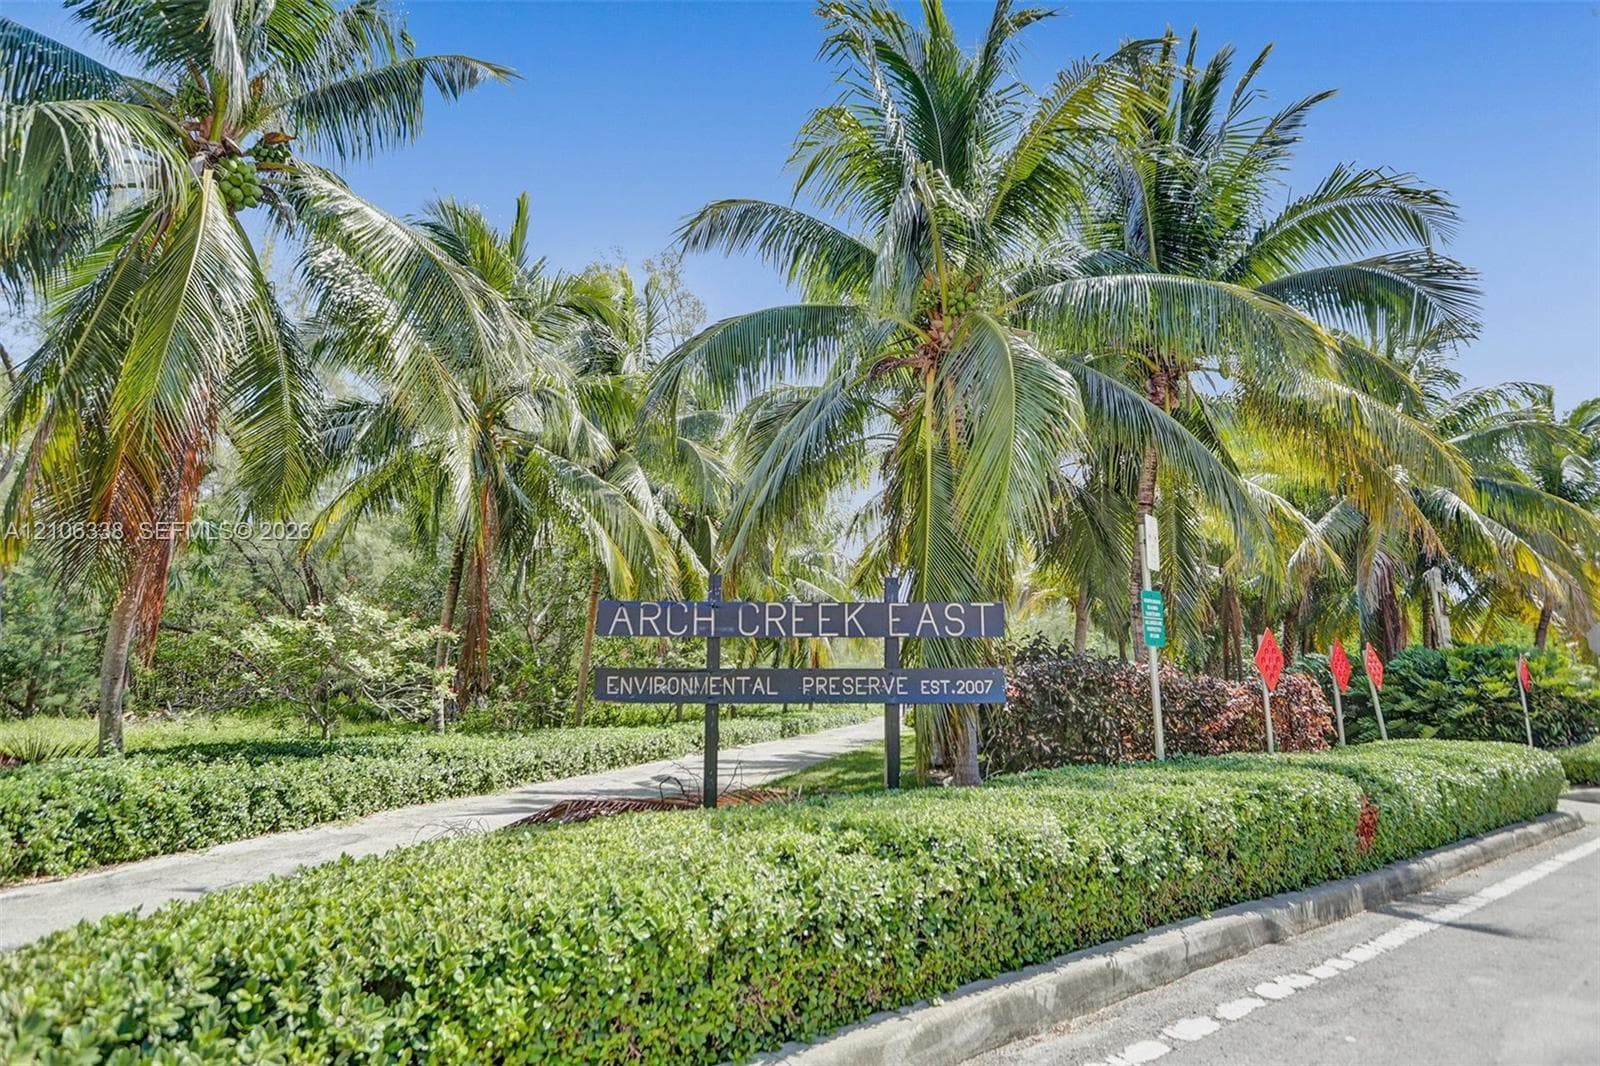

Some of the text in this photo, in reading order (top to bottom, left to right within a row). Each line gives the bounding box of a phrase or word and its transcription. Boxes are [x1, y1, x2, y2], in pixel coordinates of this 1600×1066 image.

[608, 602, 995, 637] ARCH CREEK EAST
[606, 676, 993, 696] ENVIRONMENTAL PRESERVE EST.2007
